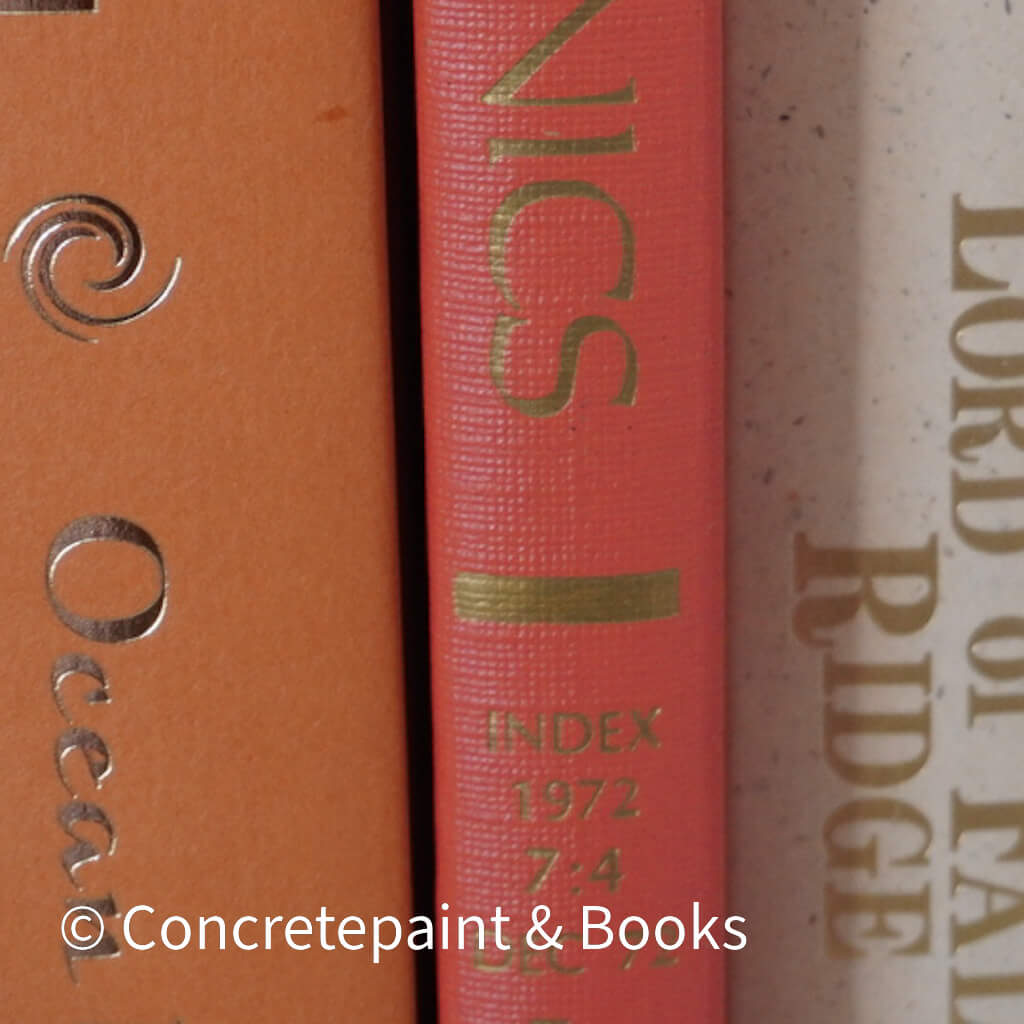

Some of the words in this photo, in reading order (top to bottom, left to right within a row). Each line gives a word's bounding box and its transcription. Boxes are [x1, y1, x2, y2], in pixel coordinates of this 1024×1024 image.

[485, 706, 663, 755] INDEX
[792, 532, 940, 960] RIDGE
[511, 778, 641, 822] 1972
[523, 846, 625, 896] 7:4
